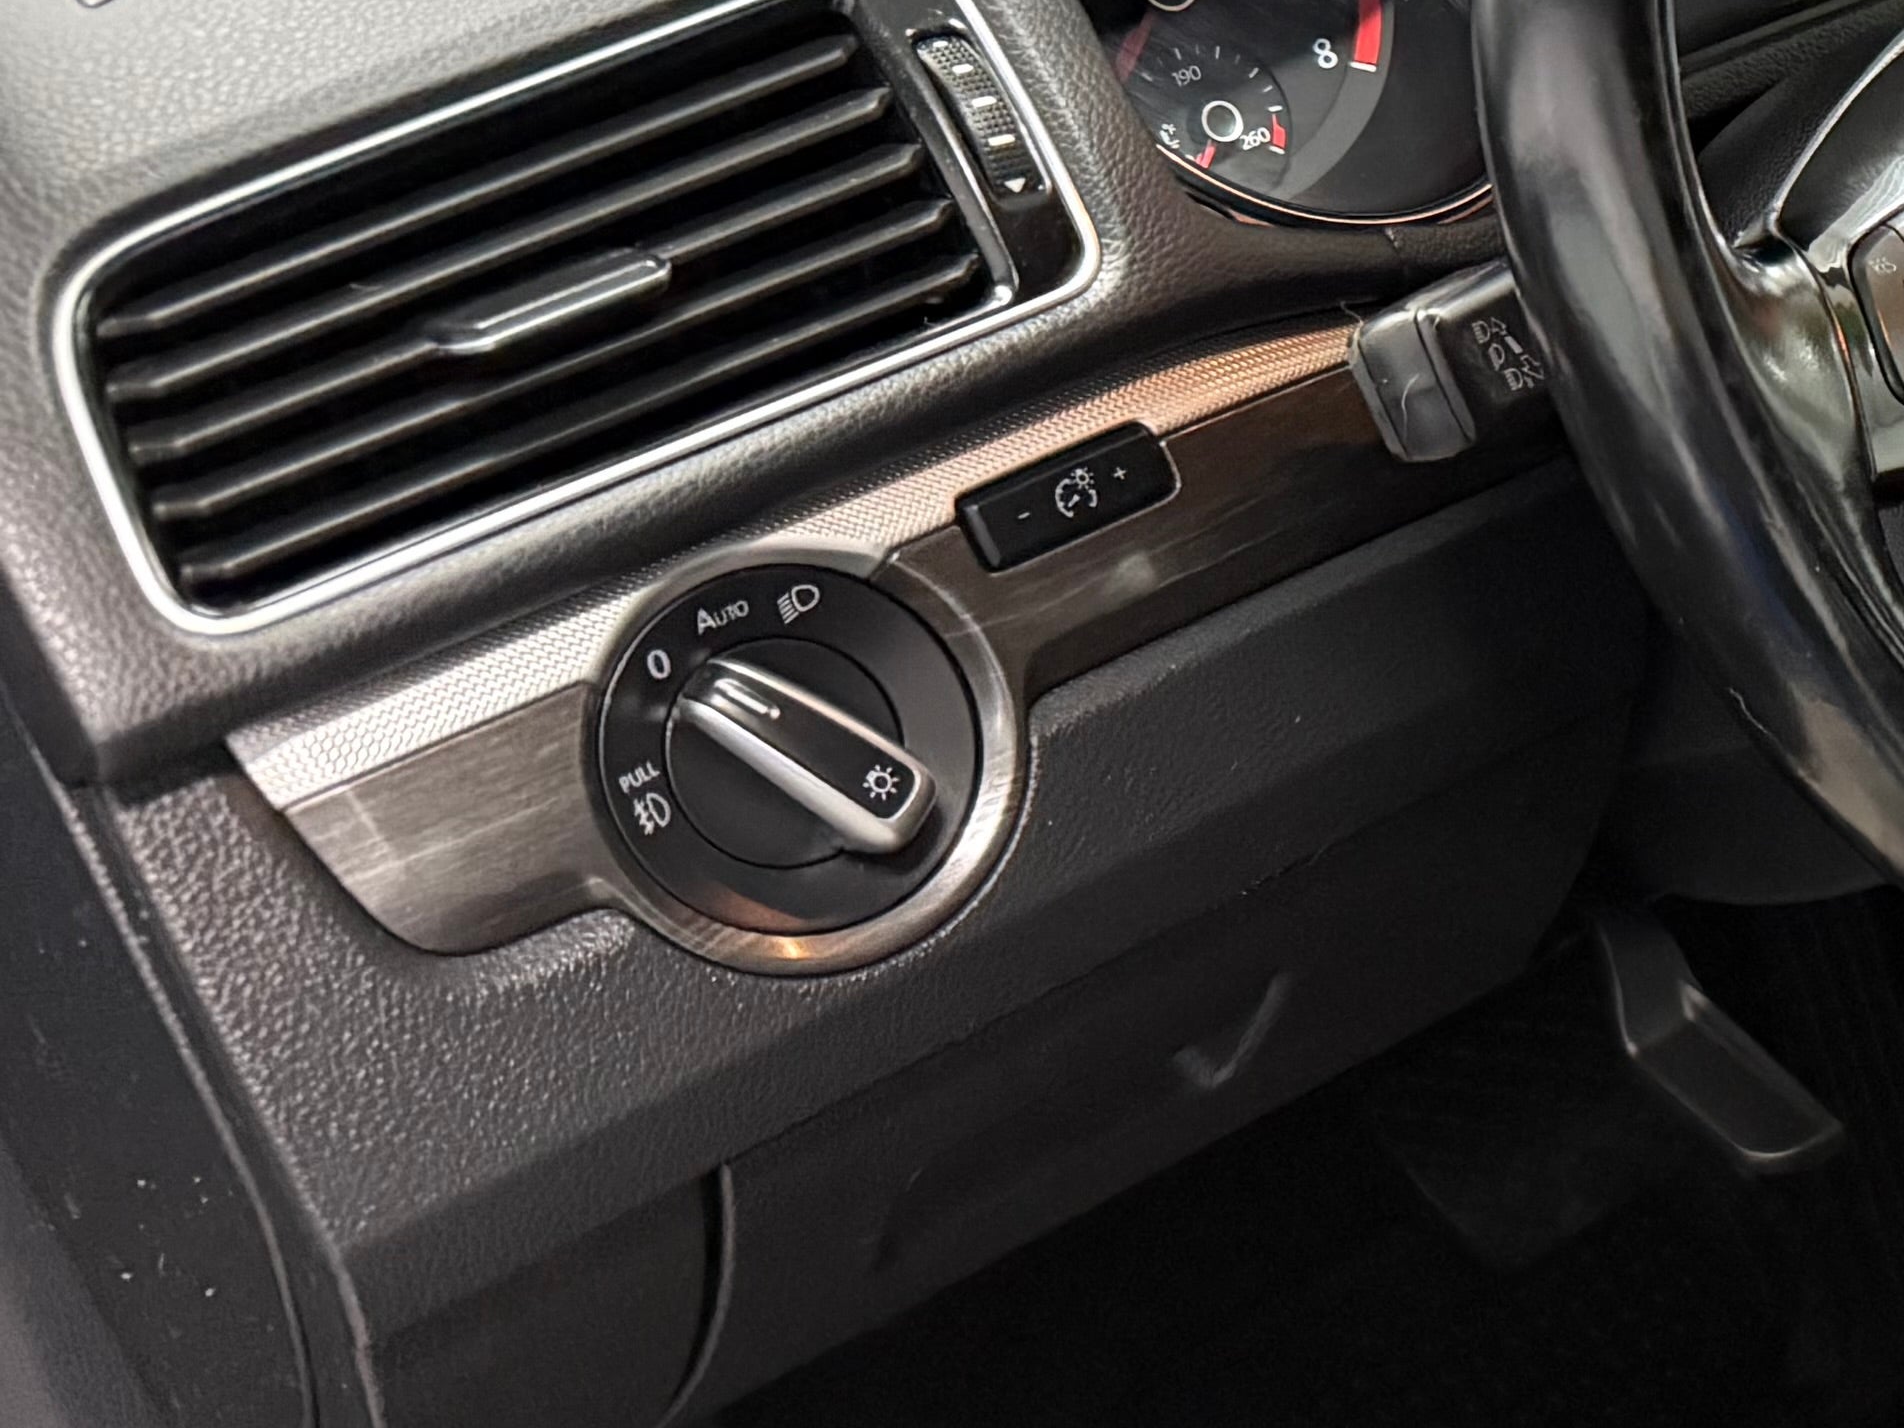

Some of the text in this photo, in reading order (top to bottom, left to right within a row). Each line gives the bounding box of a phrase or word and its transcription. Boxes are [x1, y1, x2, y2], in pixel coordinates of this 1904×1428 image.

[1311, 37, 1338, 70] 8
[1171, 64, 1202, 88] 190
[1239, 126, 1271, 152] 260
[618, 759, 662, 794] PULL
